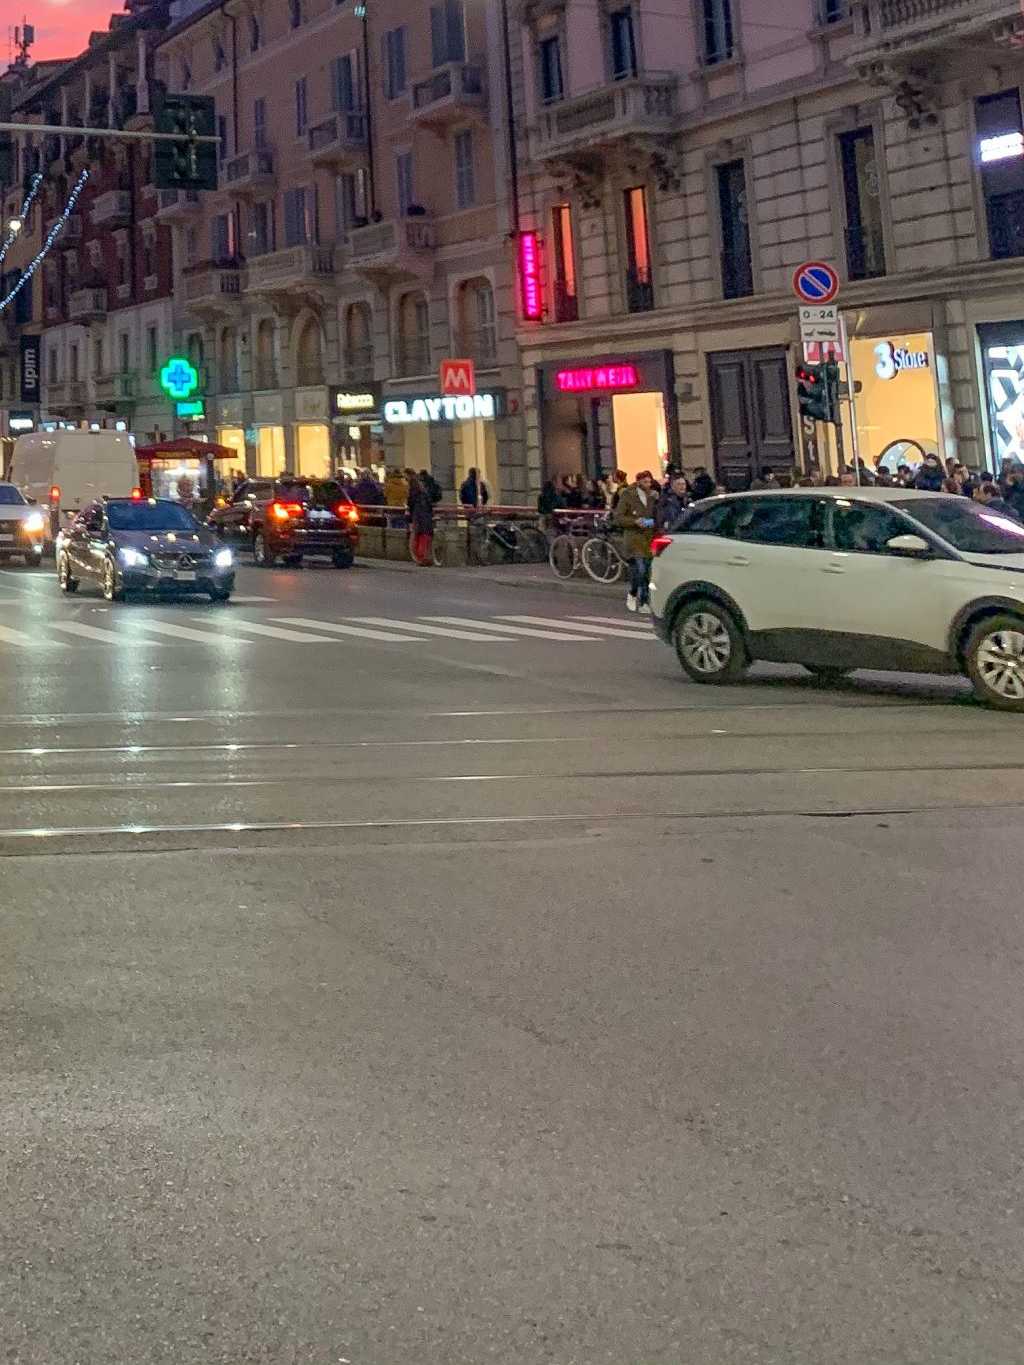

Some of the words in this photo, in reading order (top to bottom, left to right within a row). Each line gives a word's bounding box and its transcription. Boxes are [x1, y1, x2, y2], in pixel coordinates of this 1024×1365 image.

[803, 310, 811, 319] 0
[820, 310, 833, 319] 24
[24, 348, 39, 388] upim
[874, 342, 895, 379] 3
[894, 348, 929, 370] Store
[444, 367, 470, 389] M
[557, 370, 592, 389] TALLY
[384, 394, 494, 424] CLAYTON
